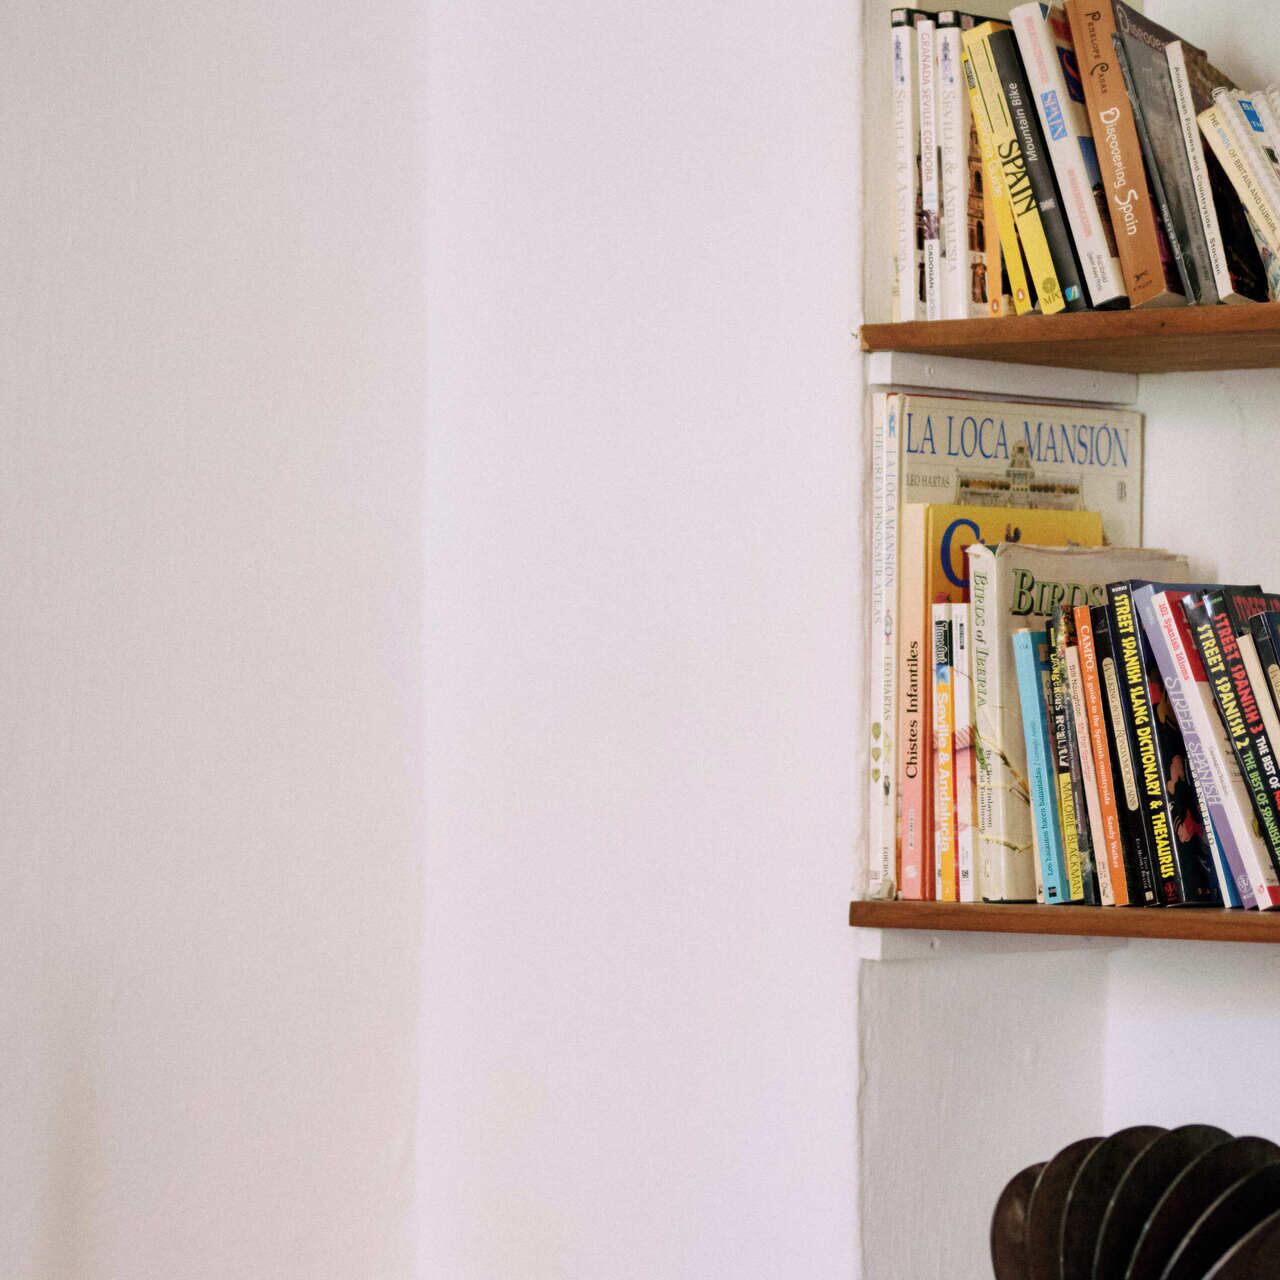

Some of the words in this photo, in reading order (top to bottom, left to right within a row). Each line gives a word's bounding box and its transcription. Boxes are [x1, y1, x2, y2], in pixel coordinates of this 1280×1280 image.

[920, 32, 931, 85] GRANADA
[921, 87, 931, 127] SEVILLE
[1008, 82, 1022, 106] Bike
[1016, 108, 1038, 161] Mountain
[1040, 91, 1067, 140] SPAIN
[997, 138, 1041, 217] SPAIN
[1192, 154, 1200, 171] and
[1208, 112, 1219, 127] THE
[1226, 147, 1239, 161] OF
[1233, 158, 1253, 189] BRITAIN
[1248, 186, 1263, 206] AND
[1258, 203, 1277, 233] EUROPE
[1113, 188, 1140, 235] Spain
[906, 412, 935, 454] LA
[946, 415, 1009, 460] LOCA
[1020, 420, 1129, 466] MANSIÓN
[906, 473, 920, 487] LEO
[1112, 592, 1135, 634] STREET
[1156, 601, 1170, 617] 101
[1080, 624, 1094, 672] CAMPO:
[1161, 617, 1181, 652] Spanish
[906, 640, 918, 713] Infantiles
[1119, 635, 1143, 684] SPANISH
[1173, 650, 1192, 681] Idioms
[1211, 611, 1241, 662] STREET
[1228, 662, 1262, 724] SPANISH
[1248, 722, 1265, 735] 3
[1086, 681, 1097, 705] guide
[1128, 685, 1150, 725] SLANG
[1195, 622, 1226, 674] STREET
[1213, 675, 1247, 737] SPANISH
[1234, 736, 1251, 750] 2
[936, 692, 950, 748] Seville
[1090, 704, 1098, 713] to
[1091, 713, 1101, 727] the
[905, 719, 917, 779] Chistes
[937, 751, 950, 766] &
[1092, 727, 1105, 760] Spanish
[1164, 675, 1199, 735] STREET
[1186, 738, 1221, 807] SPANISH
[1241, 750, 1257, 771] THE
[1254, 734, 1270, 755] THE
[1135, 726, 1162, 797] DICTIONARY
[1248, 769, 1265, 792] BEST
[1260, 754, 1276, 777] BEST
[1097, 760, 1112, 805] countryside
[1255, 791, 1269, 807] OF
[1267, 775, 1280, 791] OF
[1062, 781, 1076, 827] MALORIE
[1148, 798, 1164, 809] &
[1106, 815, 1115, 839] Sandy
[1150, 811, 1176, 878] THESAURUS
[1066, 831, 1081, 894] BLACKMAN
[1109, 840, 1120, 869] Walker
